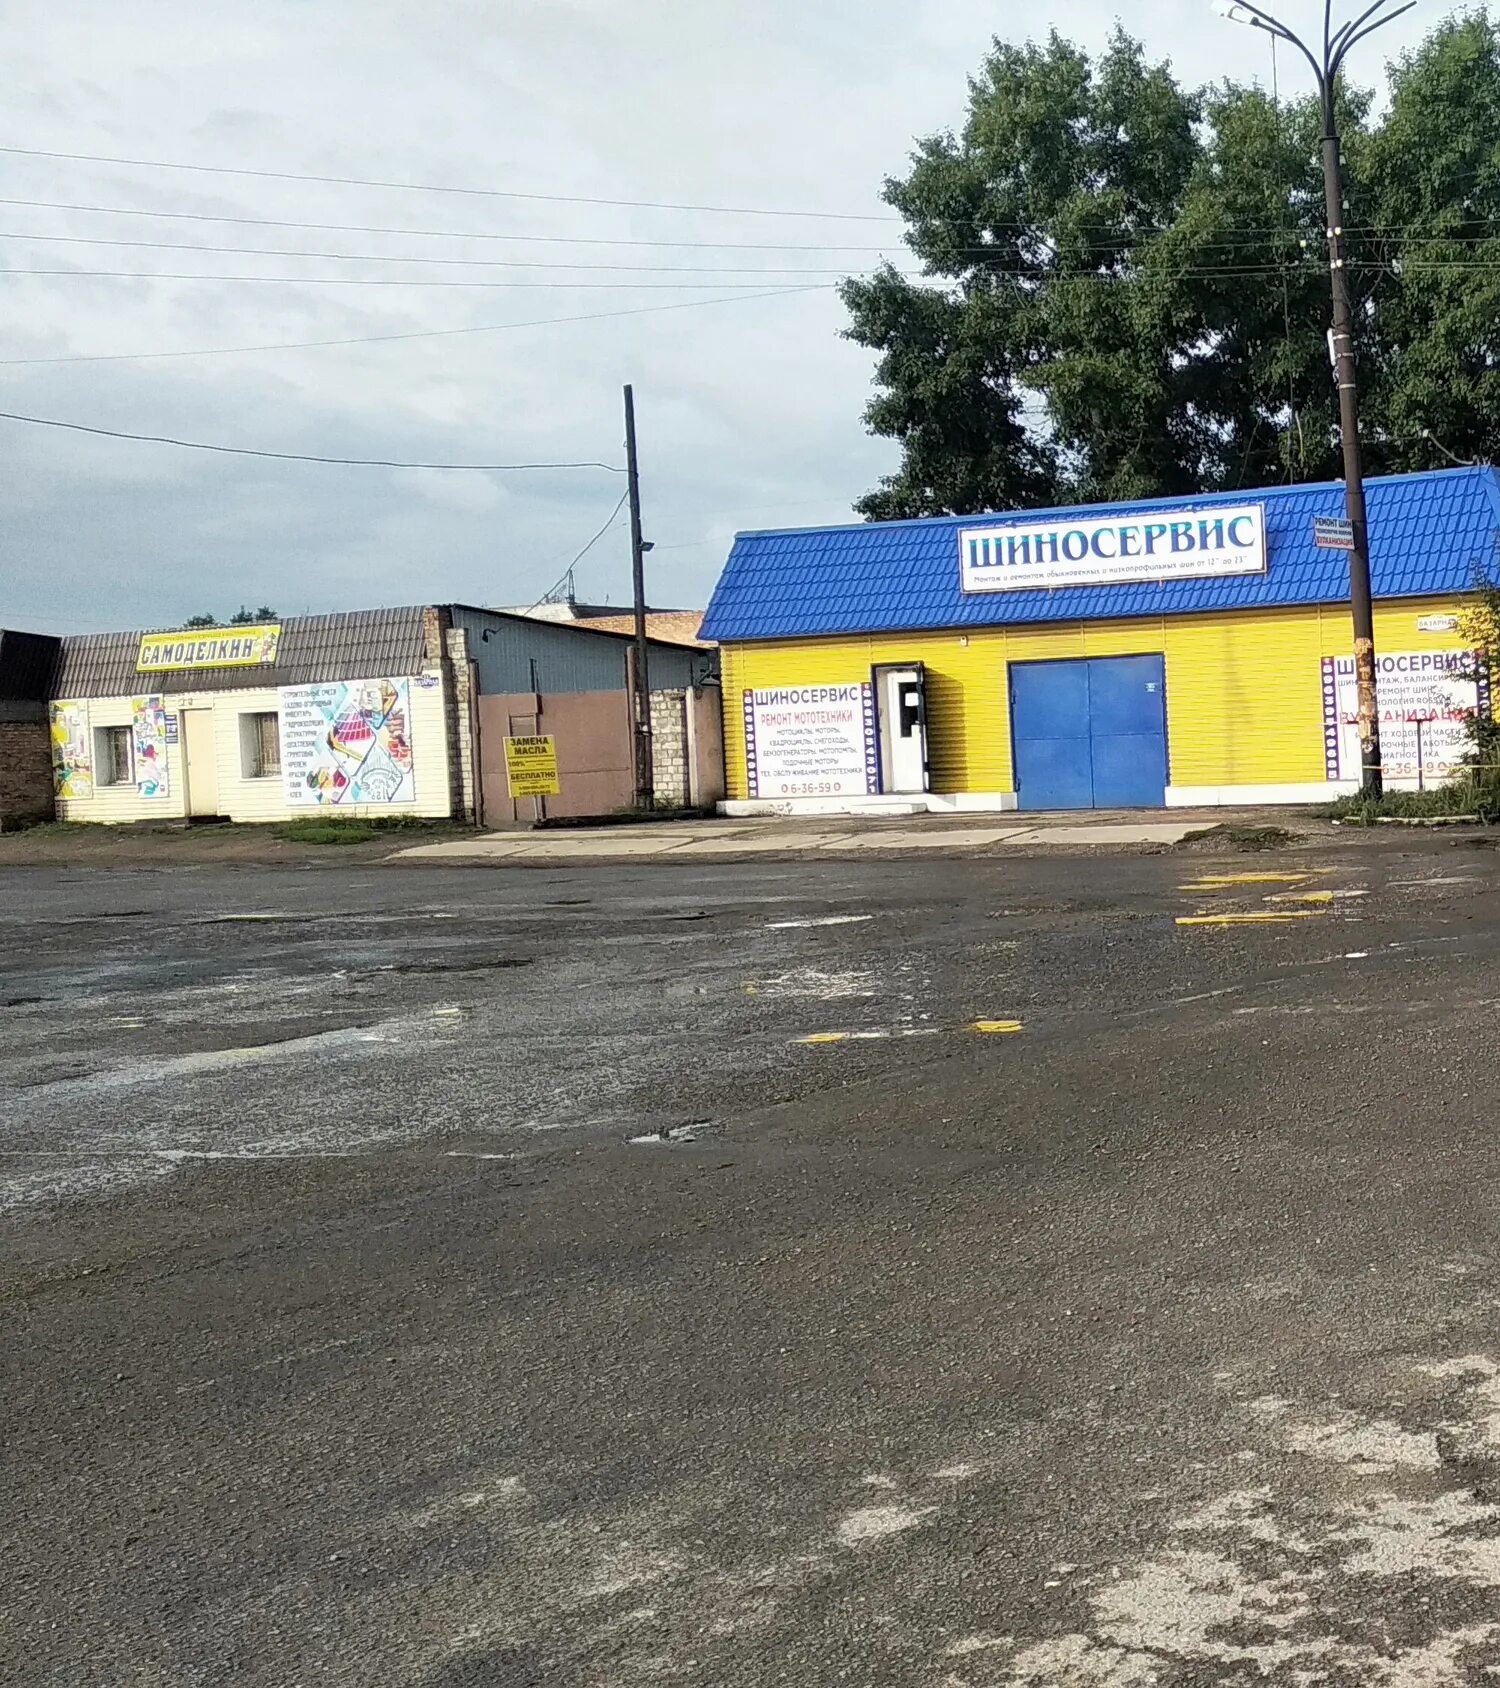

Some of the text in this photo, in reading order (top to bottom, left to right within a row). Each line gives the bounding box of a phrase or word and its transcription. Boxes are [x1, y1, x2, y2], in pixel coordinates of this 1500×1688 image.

[1315, 517, 1338, 527] РЕМОНТ
[968, 515, 1255, 569] ШИНОСЕРВИС
[1046, 569, 1100, 578] обыкновенных
[1109, 561, 1177, 574] низкопрофильных
[141, 637, 254, 665] САМОДЕЛКИН
[1337, 652, 1476, 675] ШНОСЕРВИС
[755, 687, 858, 705] ШИНОСЕРВИС
[1377, 686, 1410, 695] РЕМОНТ
[761, 709, 853, 726] РЕМОНТ МОТОТЕХНИКИ
[511, 736, 549, 746] ЗАМЕНА
[1423, 739, 1453, 747] АБОТЫ
[514, 745, 548, 755] МАСЛА
[511, 771, 556, 780] БЕСПЛАТНО
